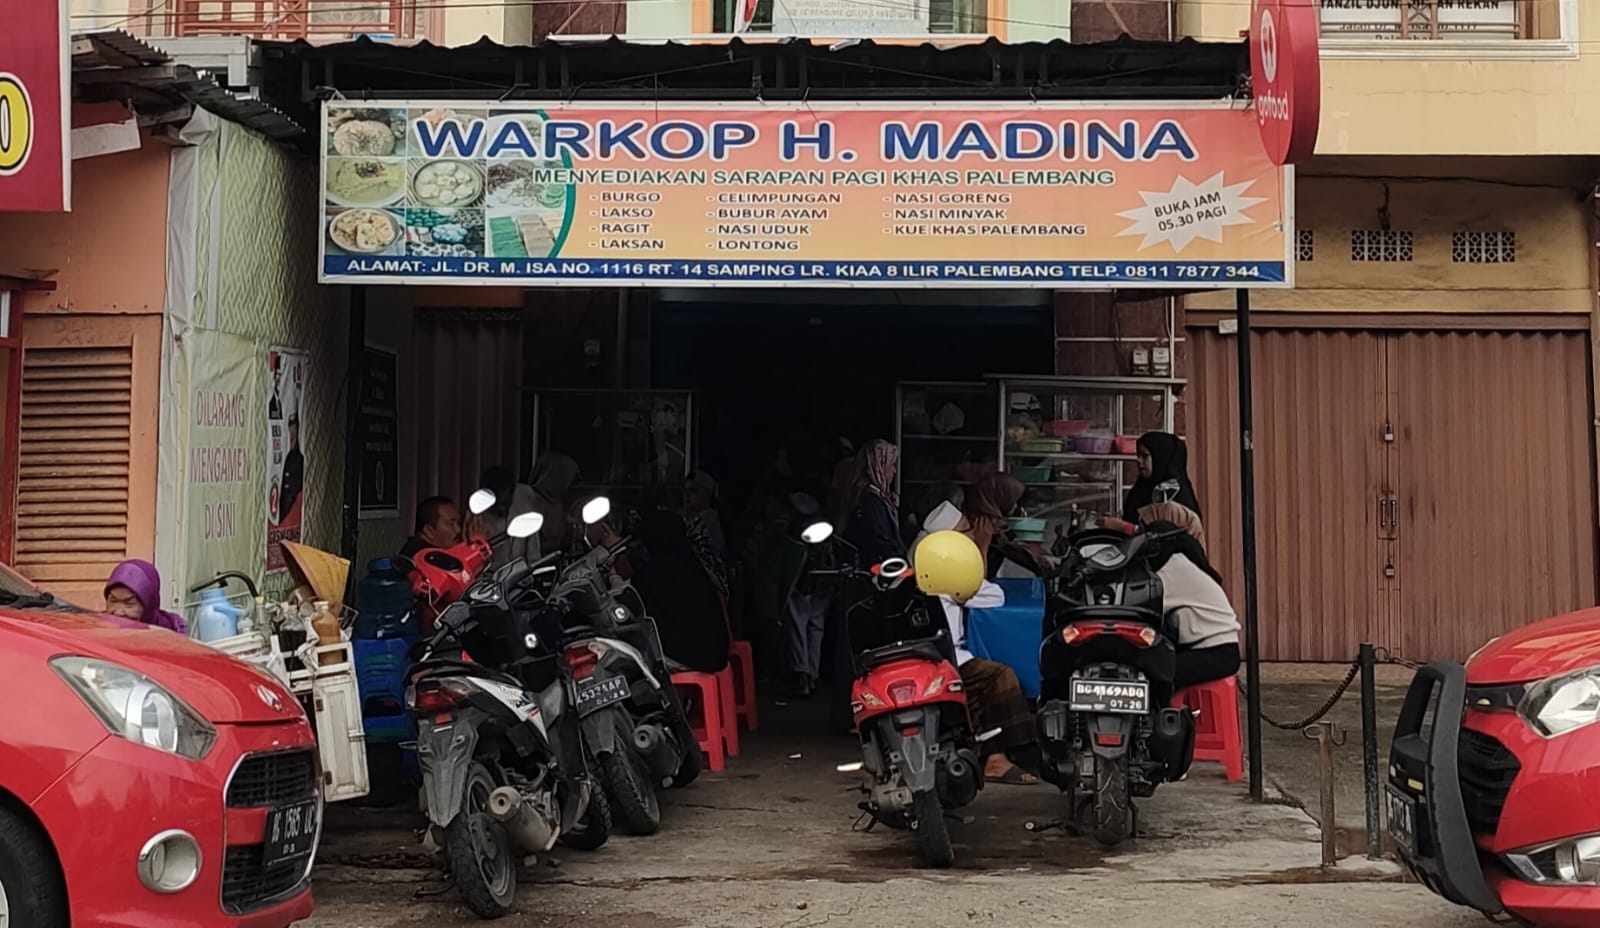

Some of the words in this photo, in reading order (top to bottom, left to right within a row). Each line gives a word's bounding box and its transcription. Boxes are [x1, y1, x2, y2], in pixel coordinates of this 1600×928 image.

[1258, 89, 1289, 126] gofood
[415, 119, 757, 160] WARKOP
[782, 121, 855, 160] H.
[883, 120, 1197, 160] MADINA
[534, 168, 706, 185] MENYEDIAKAN
[713, 169, 824, 185] SARAPAN
[832, 170, 886, 185] PAGI
[893, 170, 959, 185] KHAS
[964, 170, 1115, 186] PALEMBANG
[601, 192, 661, 202] BURGO
[718, 192, 841, 203] CELIMPUNGAN
[894, 193, 934, 203] NASI
[938, 193, 1011, 204] GORENG
[1154, 199, 1191, 218] BUKA
[1193, 191, 1221, 208] JAM
[601, 208, 654, 218] LAKSO
[718, 208, 775, 219] BUBUR
[780, 208, 828, 219] AYAM
[894, 209, 934, 219] NASI
[938, 209, 1006, 219] MINYAK
[1158, 213, 1194, 232] 05.30
[1196, 204, 1227, 221] PAGI
[601, 223, 651, 233] RAGIT
[718, 224, 757, 235] NASI
[761, 224, 810, 235] UDUK
[894, 225, 928, 235] KUE
[932, 225, 977, 235] KHAS
[981, 225, 1087, 235] PALEMBANG
[600, 239, 665, 249] LAKSAN
[718, 240, 799, 250] LONTONG
[347, 260, 427, 273] ALAMAT:
[431, 261, 458, 274] JL.
[463, 261, 495, 274] DR.
[500, 262, 521, 274] M.
[526, 262, 558, 274] ISA
[562, 263, 595, 275] NO.
[600, 263, 644, 275] 1116
[649, 264, 675, 275] RT.
[680, 264, 702, 275] 14
[707, 264, 796, 276] SAMPING
[800, 264, 830, 277] LR.
[835, 264, 882, 277] KIAA
[886, 265, 898, 277] 8
[902, 265, 939, 277] ILIR
[943, 265, 1064, 277] PALEMBANG
[1068, 265, 1121, 277] TELP.
[1124, 265, 1169, 278] 0811
[1175, 265, 1221, 278] 7877
[1225, 265, 1260, 278] 344
[196, 390, 246, 429] DILARANG
[190, 447, 251, 484] MENGAMEN
[204, 503, 214, 540] DI
[216, 503, 236, 539] SINI
